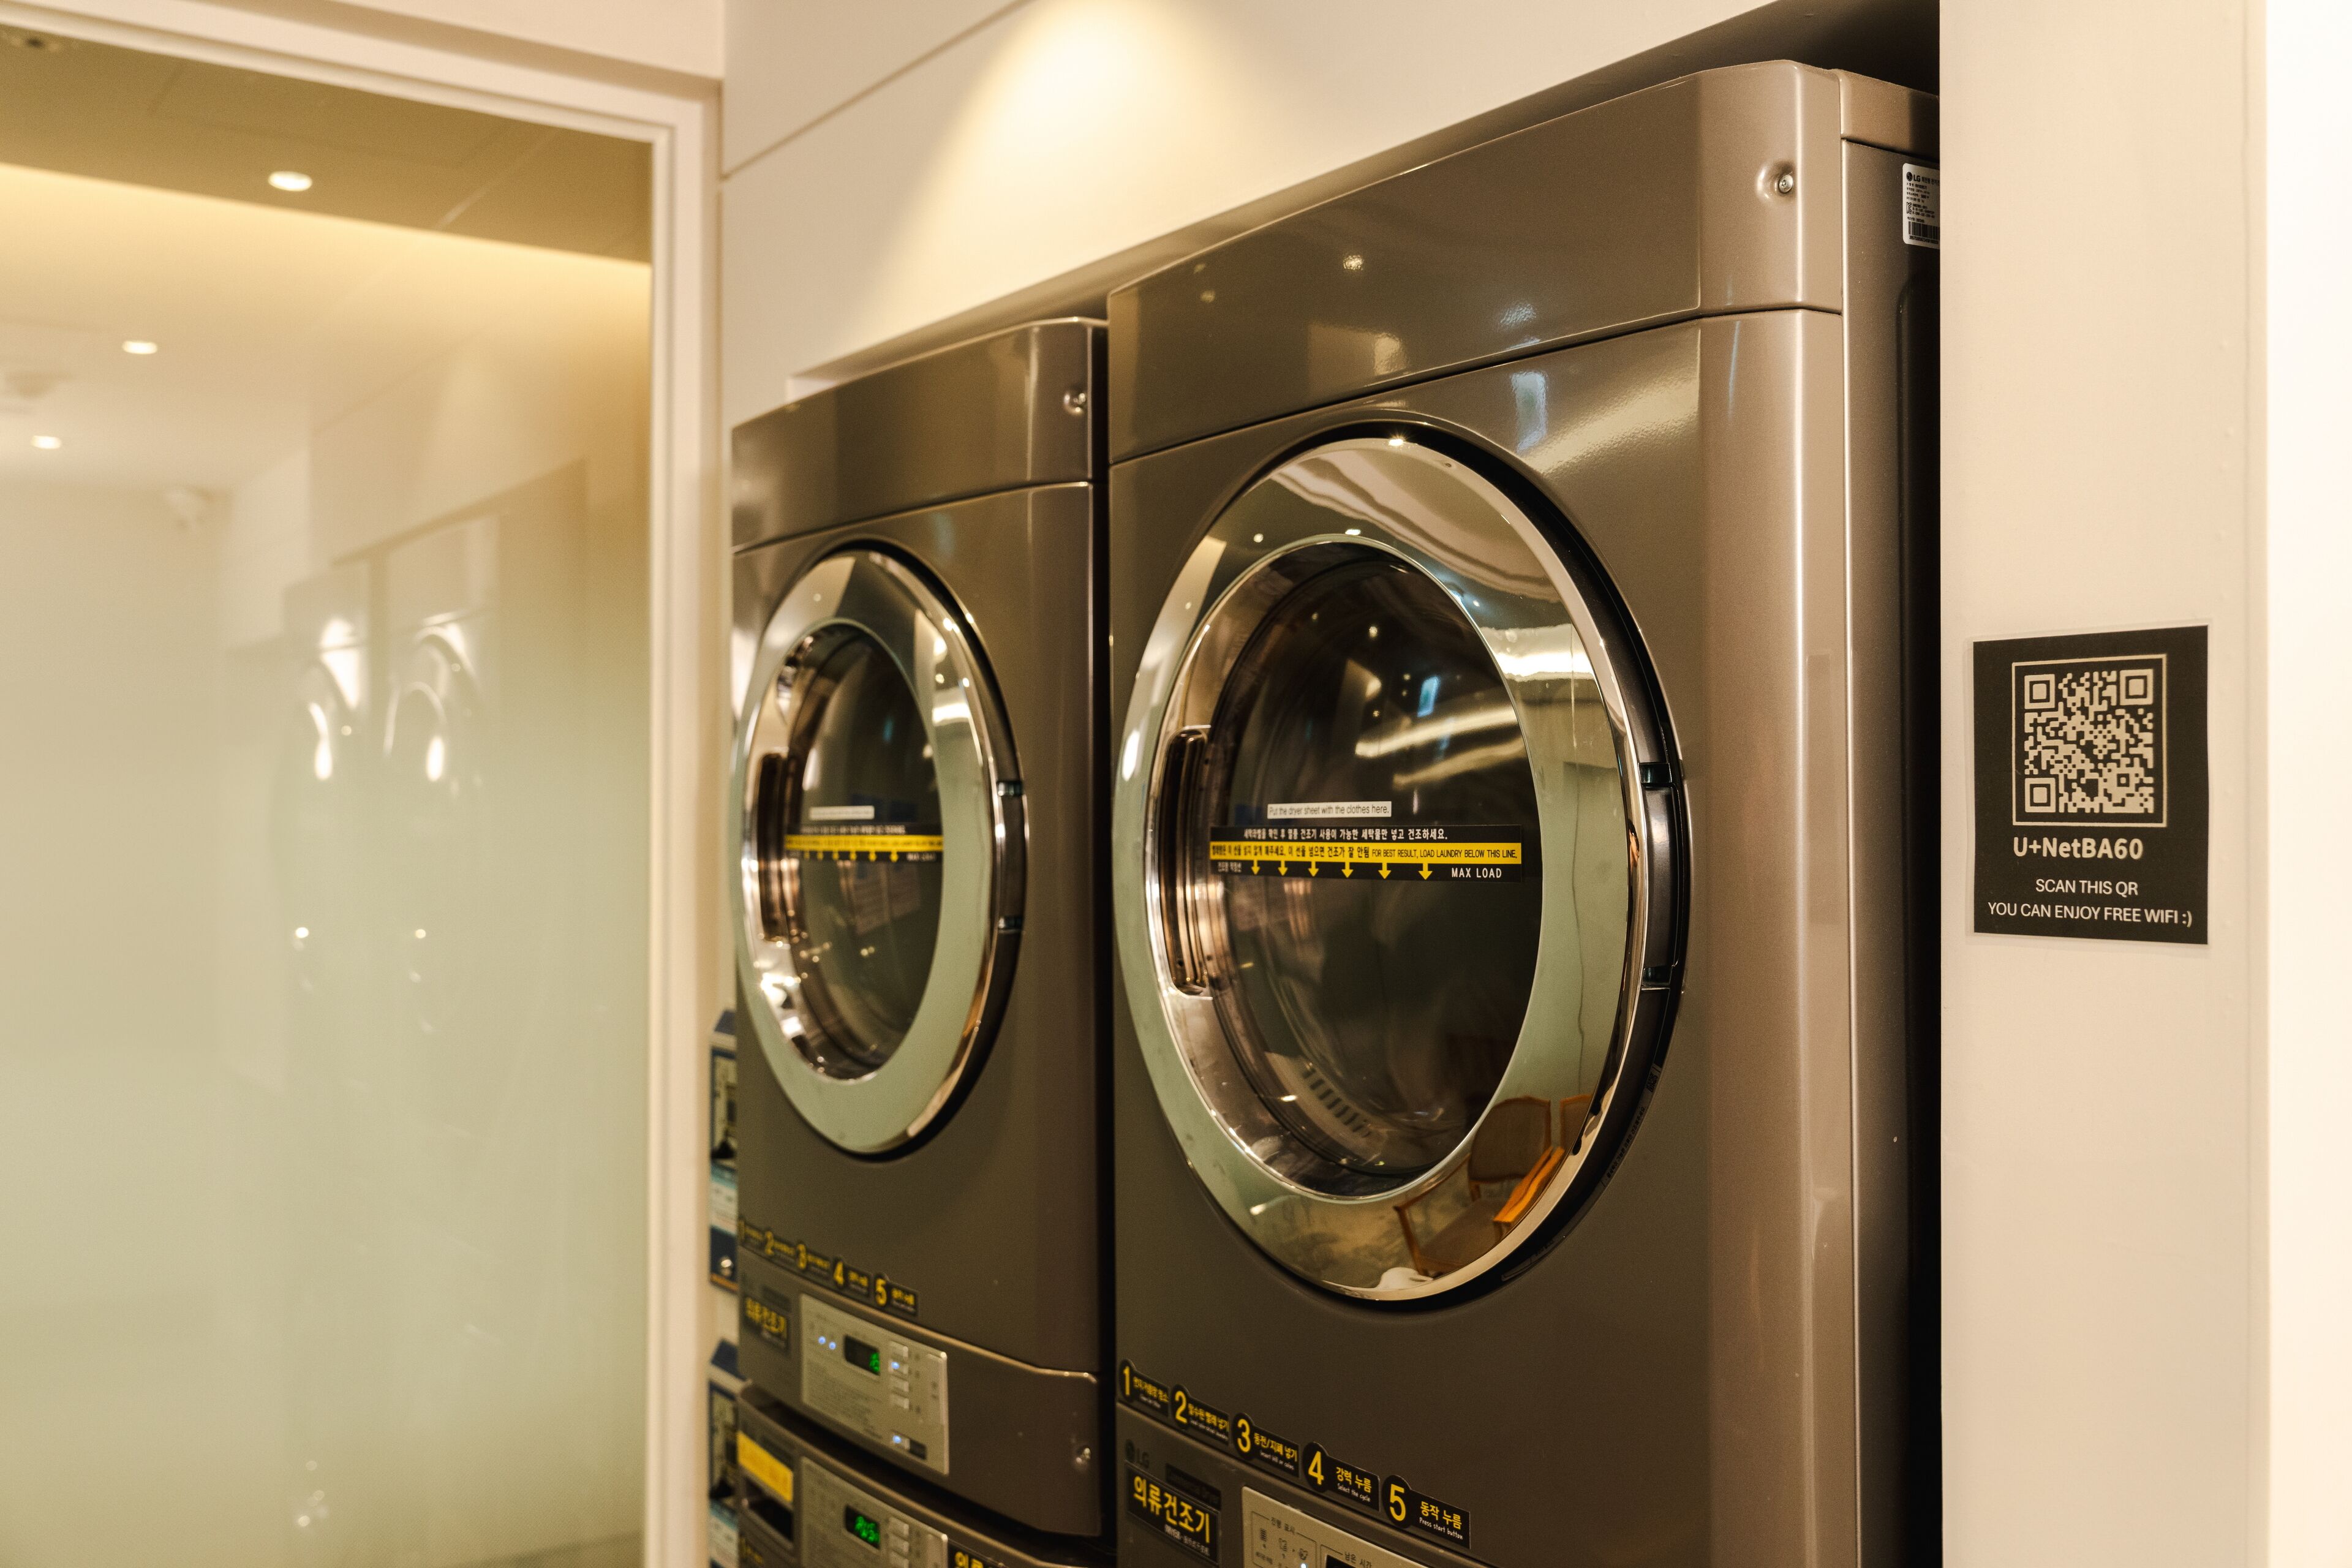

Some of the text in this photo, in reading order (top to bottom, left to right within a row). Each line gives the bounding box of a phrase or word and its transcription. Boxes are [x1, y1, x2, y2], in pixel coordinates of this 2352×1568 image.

[1288, 806, 1302, 816] dryer
[1304, 805, 1319, 815] sheet
[1321, 805, 1333, 814] with
[1335, 805, 1344, 814] the
[1346, 805, 1370, 814] clothes
[1371, 804, 1389, 813] here.
[1300, 828, 1317, 840] 건조기
[1319, 828, 1336, 840] 사용이
[1340, 828, 1359, 840] 가능한
[1362, 828, 1387, 840] 세탁물만
[1391, 828, 1404, 840] 넣고
[1408, 828, 1448, 840] 건조하세요.
[1288, 846, 1293, 856] 이
[1296, 846, 1305, 857] 선을
[1308, 846, 1324, 858] 넘으면
[1327, 846, 1344, 858] 건조가
[1348, 846, 1354, 858] 잘
[1357, 846, 1369, 858] 안됨
[1372, 849, 1381, 858] FOR
[1383, 849, 1395, 858] BEST
[1398, 849, 1418, 859] RESULT,
[2013, 837, 2143, 859] U+NetBA60
[1452, 867, 1502, 878] MAX LOAD
[2036, 879, 2138, 897] SCAN THIS QR
[1988, 902, 2017, 916] YOU
[2021, 903, 2051, 918] CAN
[2055, 905, 2100, 919] ENJOY
[2104, 907, 2141, 922] FREE
[2144, 908, 2179, 924] WIFI
[834, 1261, 844, 1285] 4
[875, 1278, 887, 1306] 5
[1123, 1365, 1130, 1396] 1
[1174, 1390, 1188, 1424] 2
[1218, 1418, 1229, 1432] 넣기
[1237, 1419, 1251, 1453] 3
[1284, 1446, 1298, 1462] 넣기
[1308, 1450, 1324, 1485] 4
[1336, 1466, 1372, 1493] 강력 누름
[1133, 1476, 1210, 1544] 의류건조기
[1390, 1483, 1406, 1521] 5
[1420, 1501, 1462, 1530] 동작 누름
[1419, 1517, 1463, 1540] Press start button
